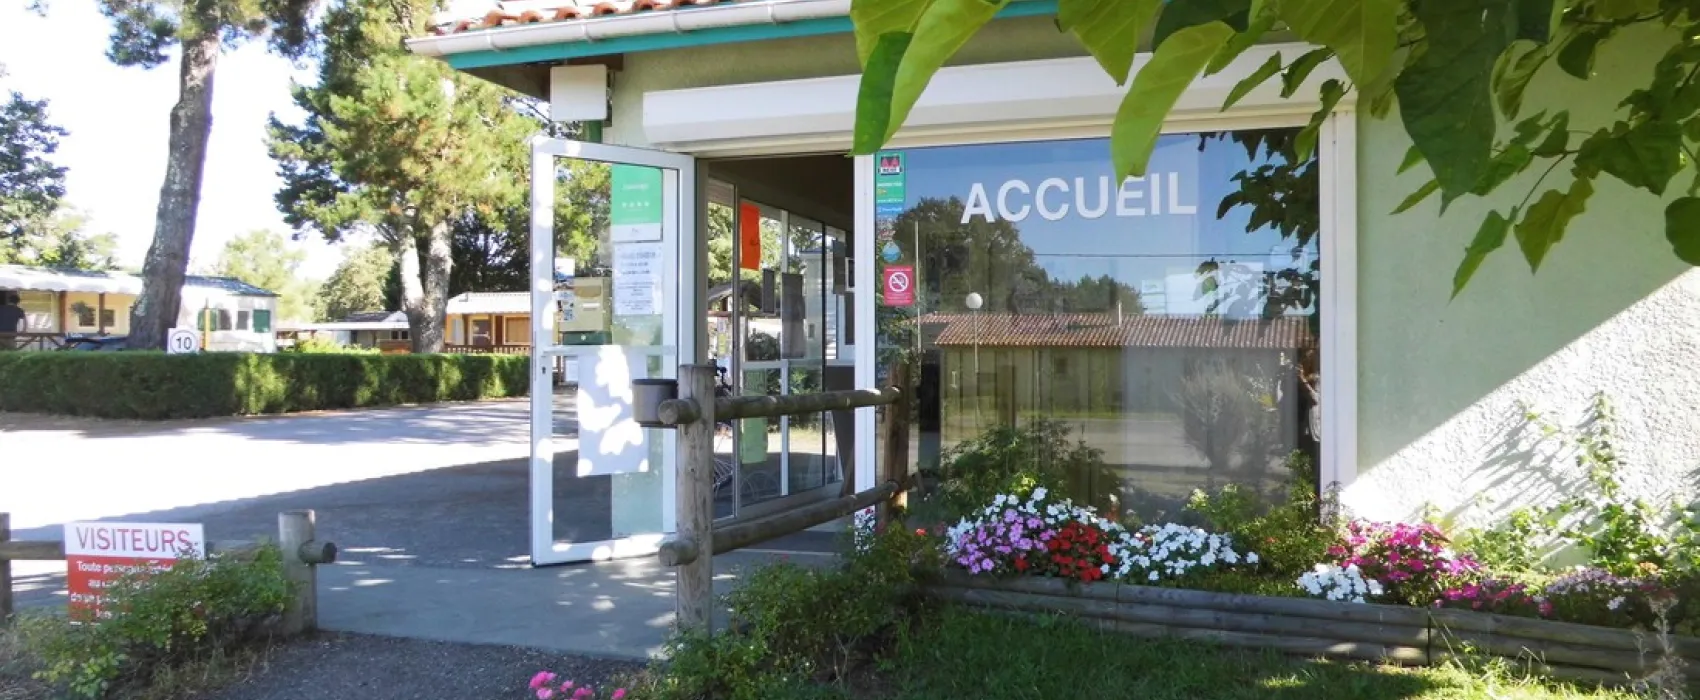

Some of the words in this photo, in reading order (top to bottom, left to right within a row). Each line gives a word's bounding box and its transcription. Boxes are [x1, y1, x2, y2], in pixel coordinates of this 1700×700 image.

[960, 171, 1197, 224] ACCUEIL
[175, 336, 193, 350] 10
[75, 526, 194, 553] VISITEURS
[76, 560, 102, 572] Toute
